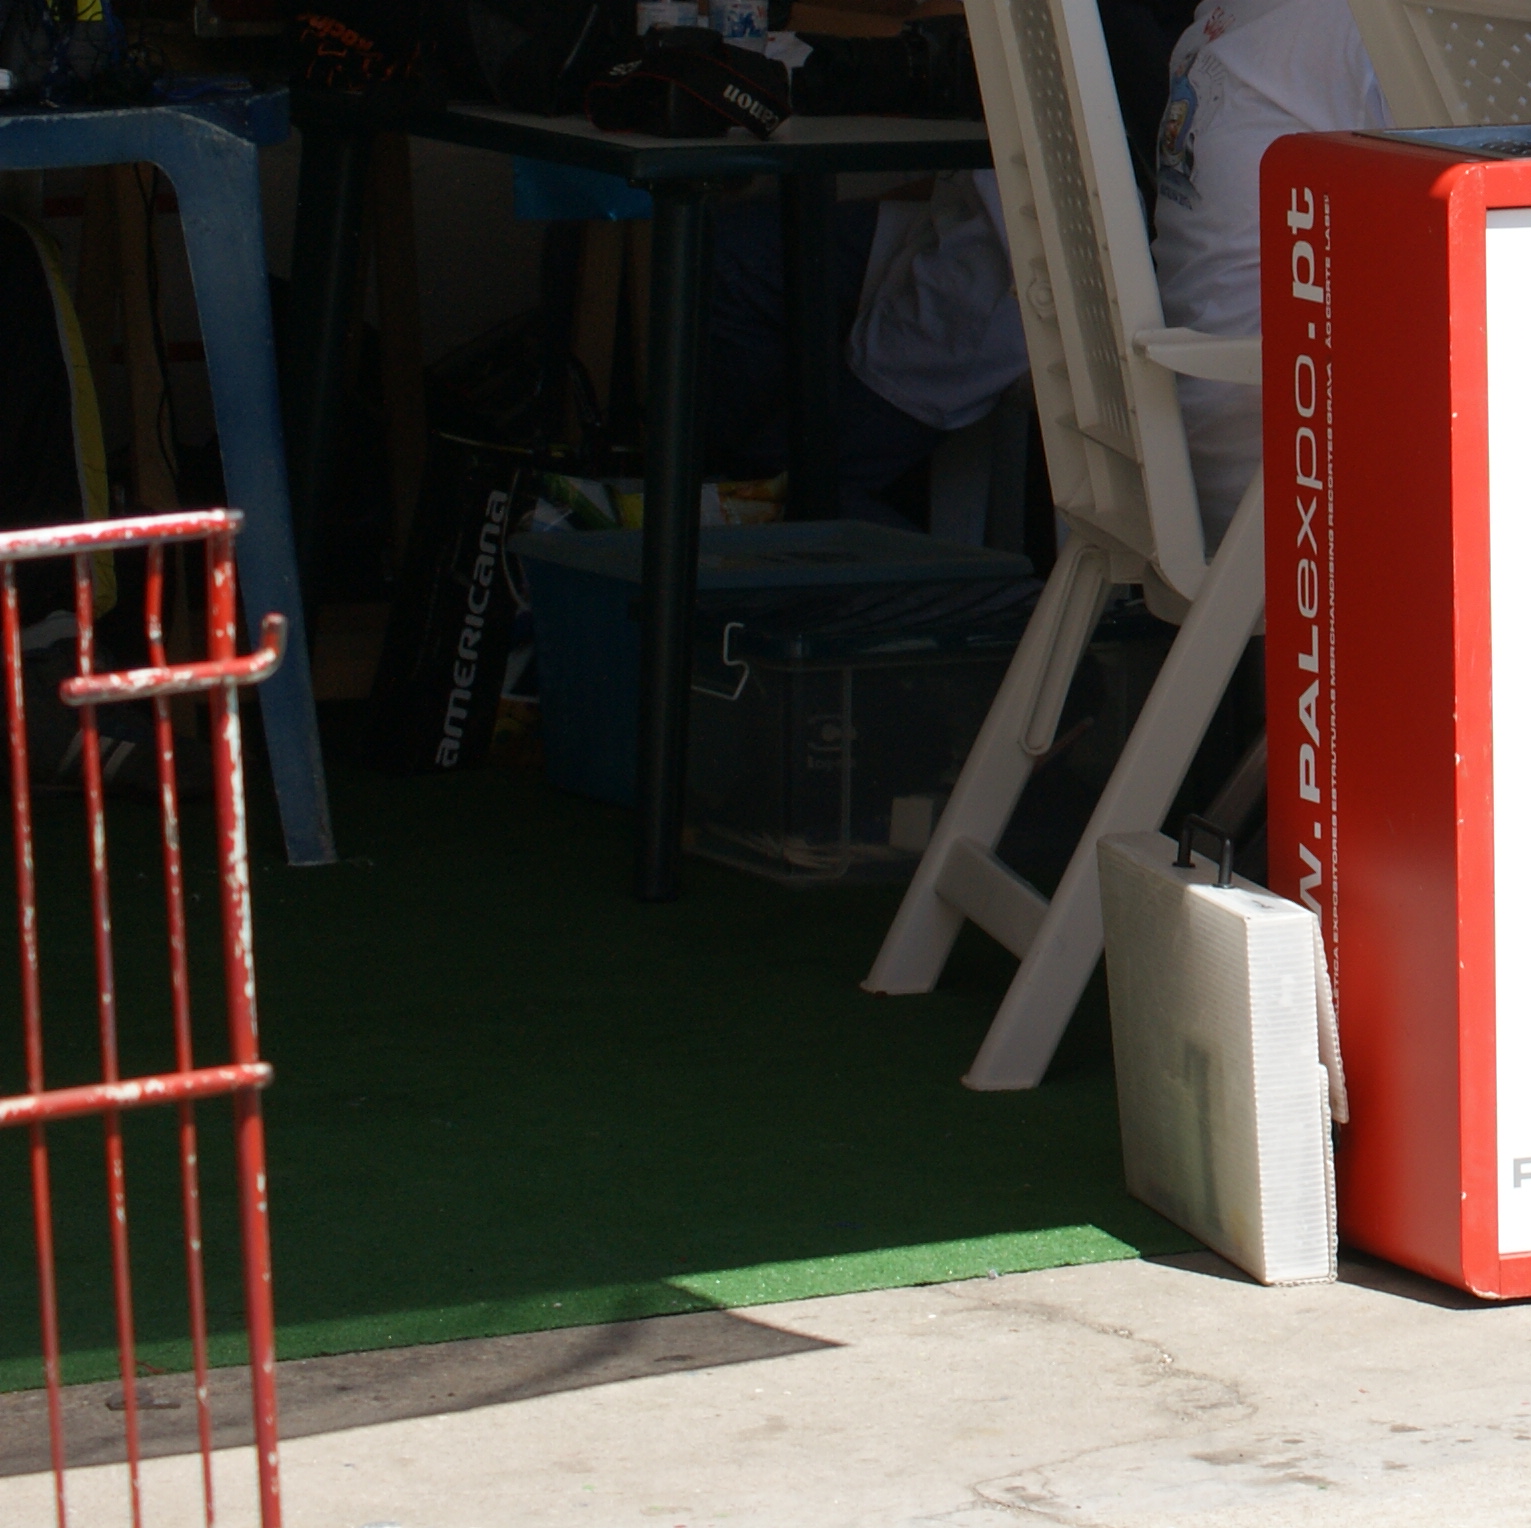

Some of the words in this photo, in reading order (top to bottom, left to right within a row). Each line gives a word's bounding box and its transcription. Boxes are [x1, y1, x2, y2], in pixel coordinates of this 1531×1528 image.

[722, 82, 781, 131] Canon
[1326, 426, 1334, 527] RECORTES
[1327, 529, 1336, 687] MERCHANDISING
[1329, 688, 1337, 813] ESTRUTURAS
